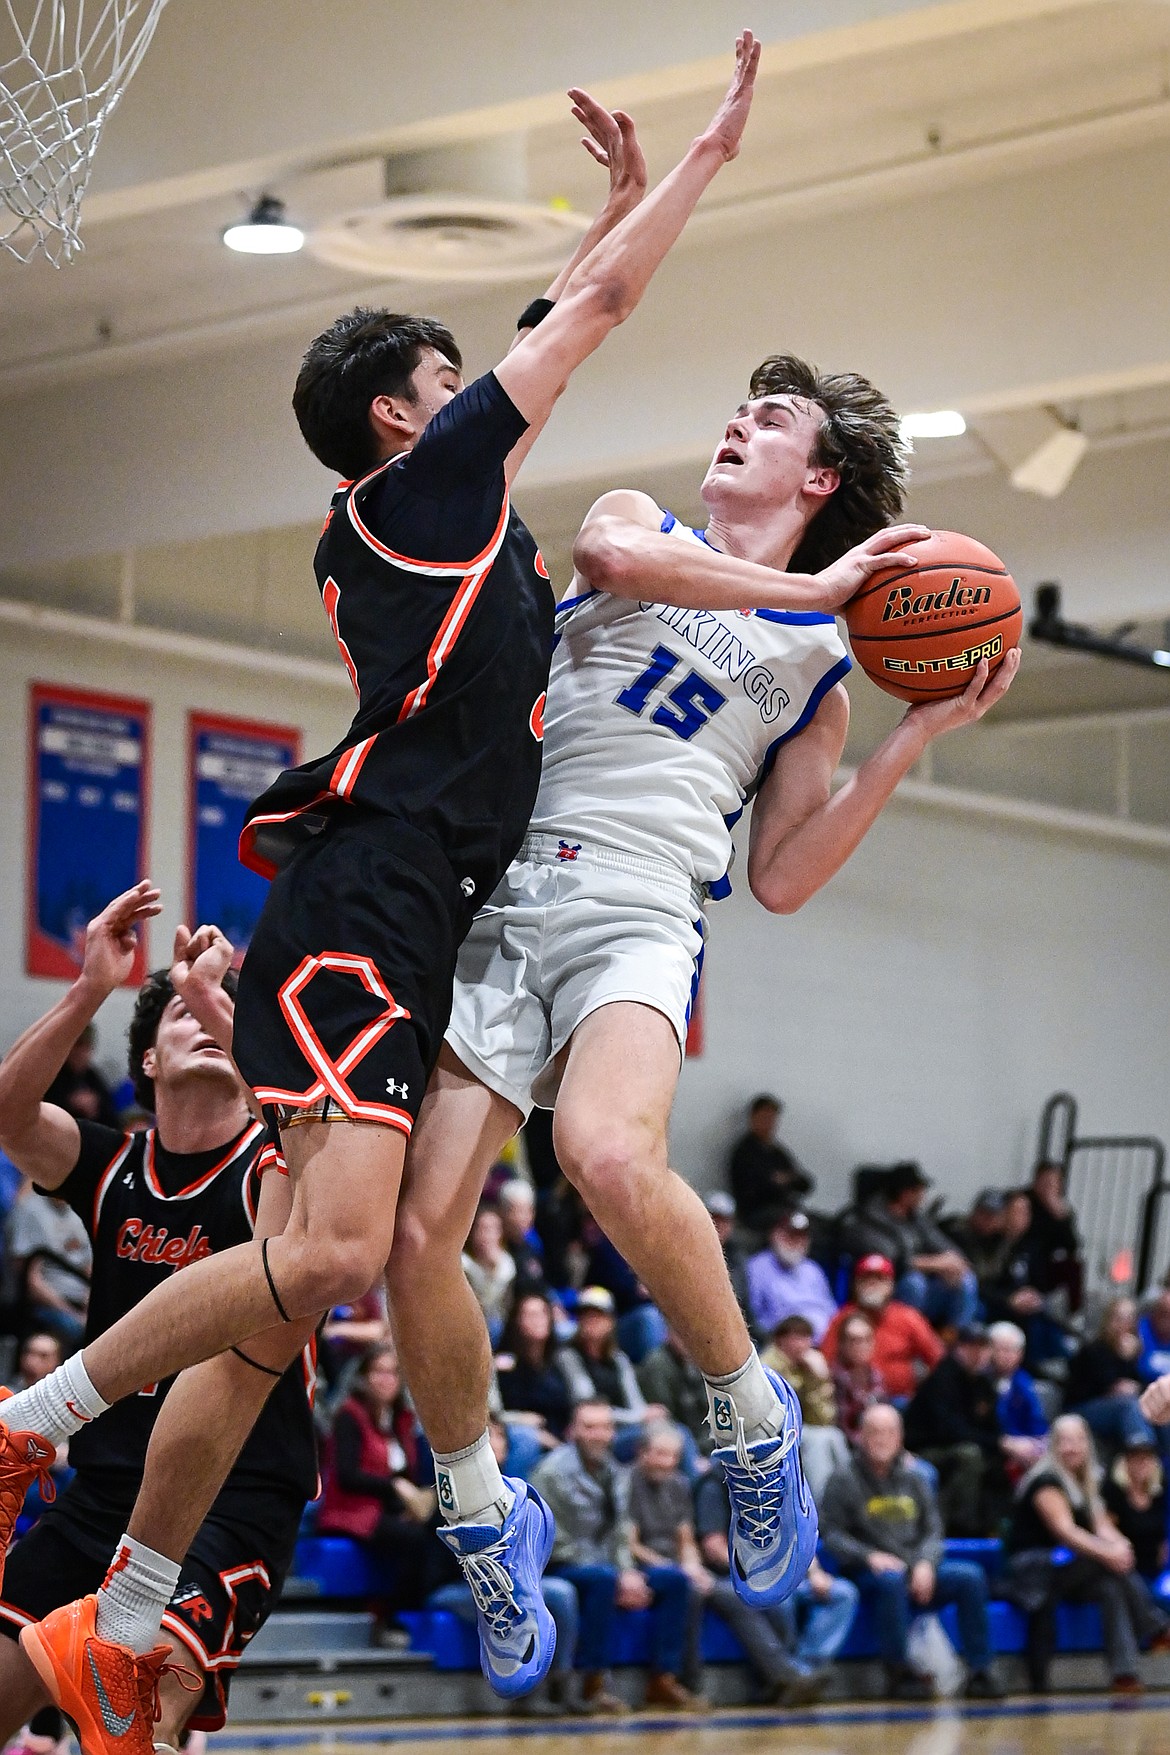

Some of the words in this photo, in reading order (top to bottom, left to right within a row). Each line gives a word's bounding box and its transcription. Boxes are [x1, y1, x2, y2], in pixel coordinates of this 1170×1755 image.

[881, 577, 991, 622] Baden
[903, 609, 976, 626] PERFECTION
[883, 654, 967, 673] ELITE
[612, 641, 729, 742] 15
[115, 1217, 213, 1275] Chiefs
